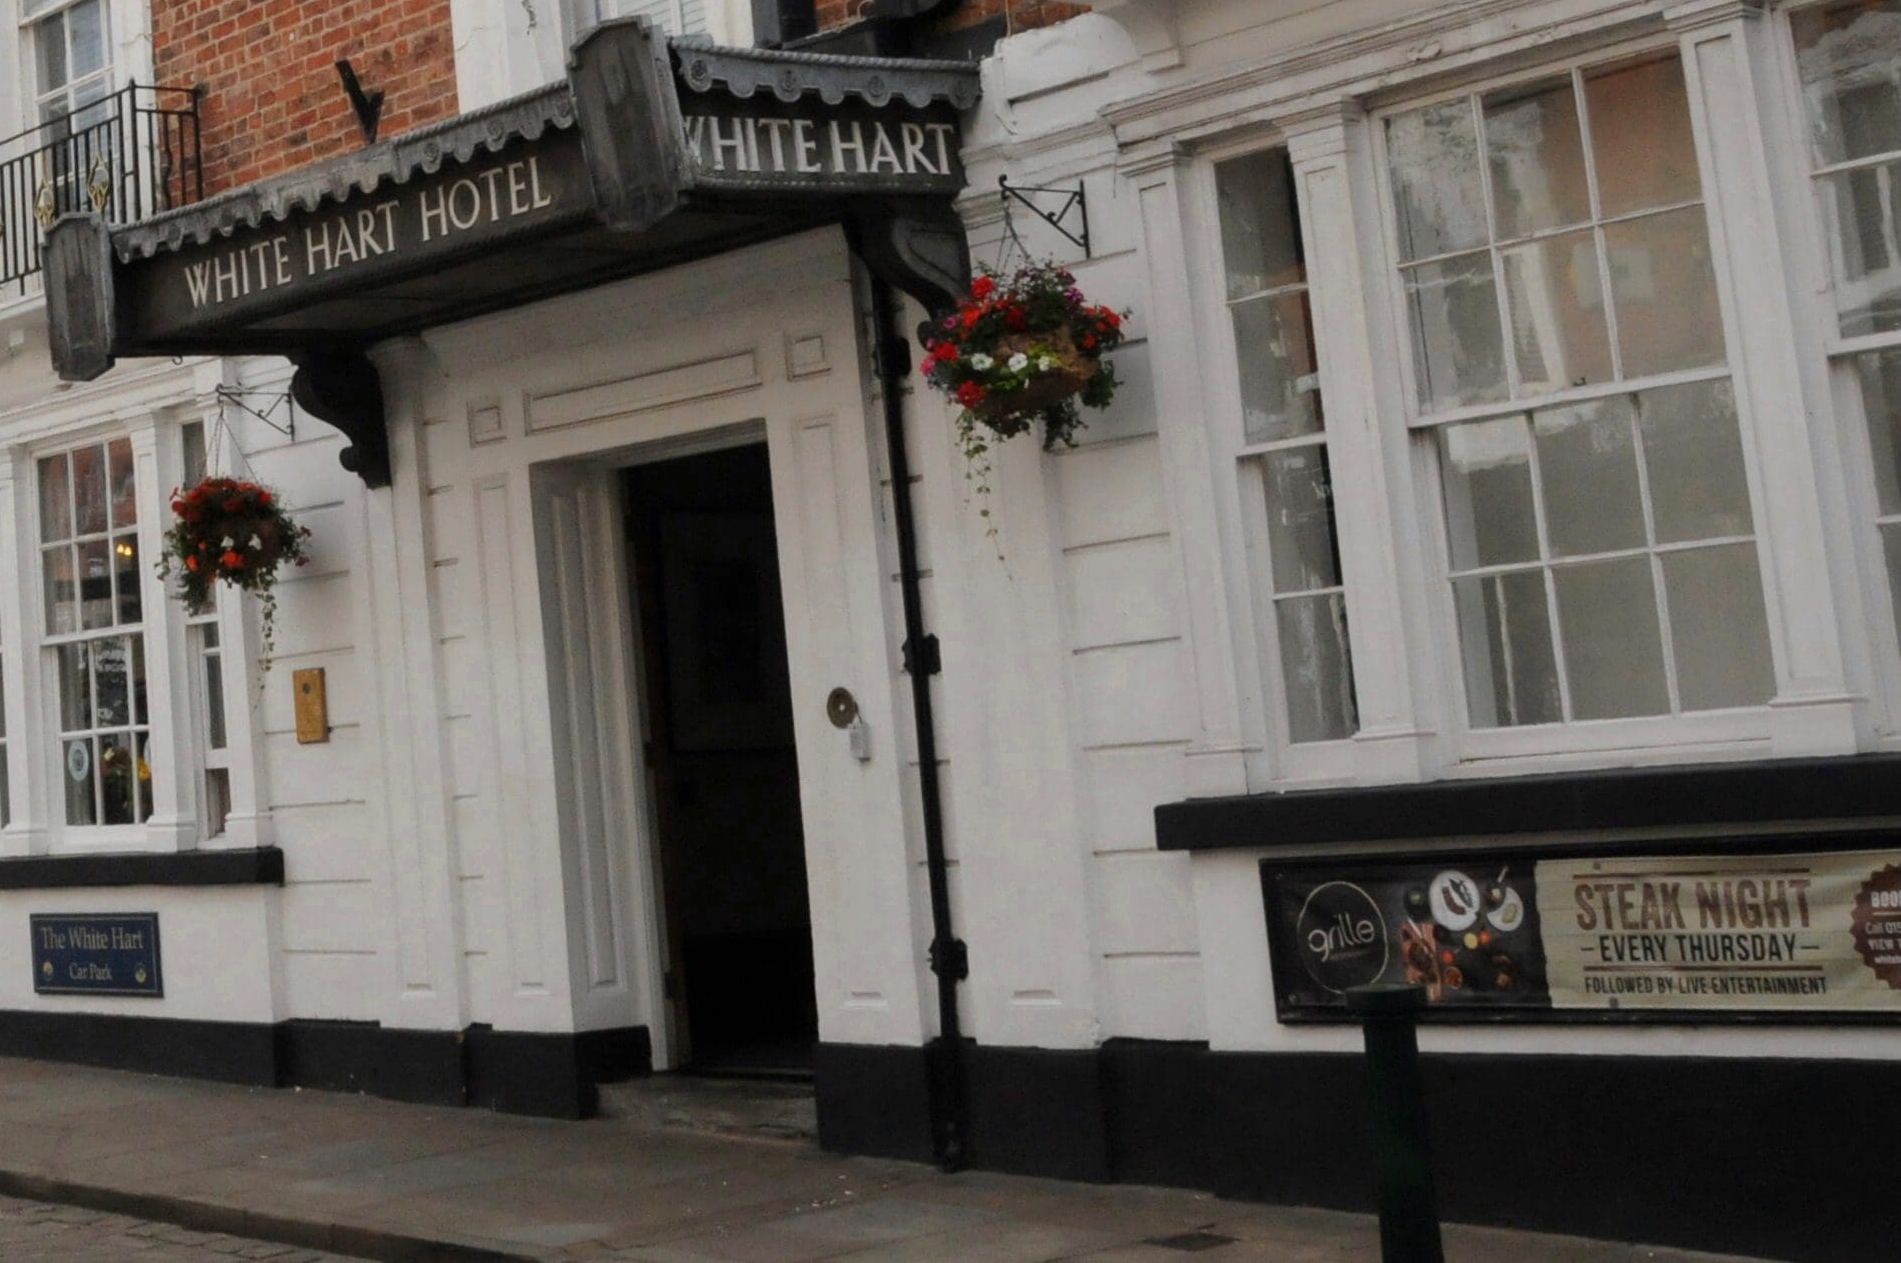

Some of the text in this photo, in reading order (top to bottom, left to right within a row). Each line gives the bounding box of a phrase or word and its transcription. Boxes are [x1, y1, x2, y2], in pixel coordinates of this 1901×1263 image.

[682, 115, 955, 175] WHITE HART
[184, 157, 552, 308] WHITE HART HOTEL
[1574, 879, 1811, 931] STEAK NIGHT
[41, 925, 144, 949] The White Hart
[1308, 912, 1376, 963] grille
[1600, 933, 1797, 962] EVERY THURSDAY
[69, 962, 114, 980] Car Park
[1584, 976, 1827, 995] FOLLOWED BY LIVE ENTERTAINMENT
